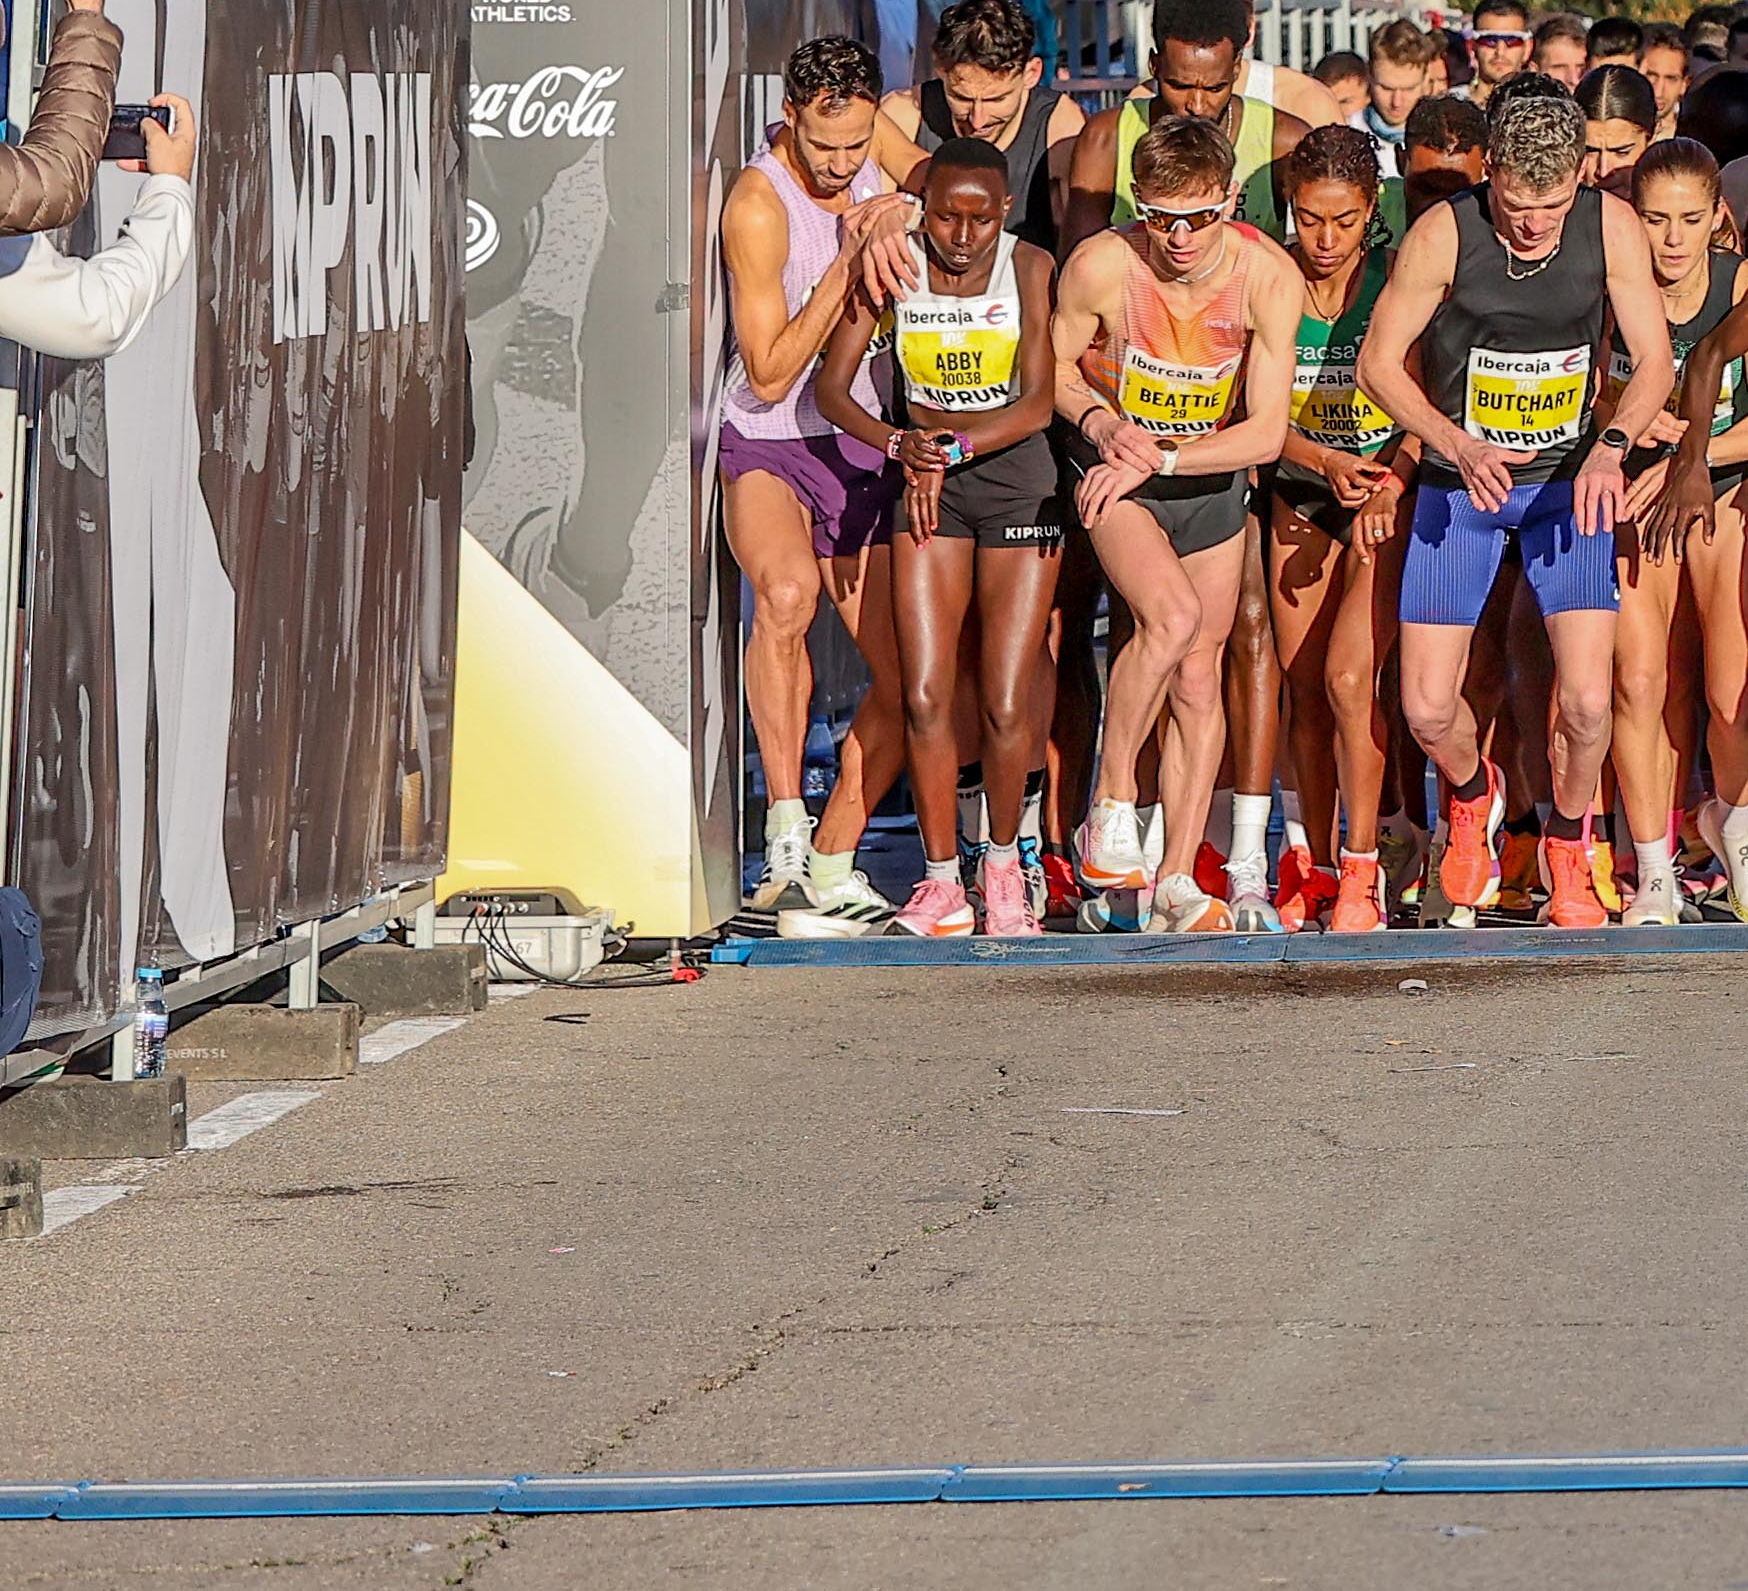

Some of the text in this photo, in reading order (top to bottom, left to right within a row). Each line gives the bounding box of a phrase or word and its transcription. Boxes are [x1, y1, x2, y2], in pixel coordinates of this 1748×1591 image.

[469, 65, 625, 140] ca-Cola
[268, 72, 432, 346] KIPRUN
[903, 308, 973, 326] Ibercaja
[936, 350, 983, 371] ABBY
[1131, 353, 1204, 381] Ibercaja
[1477, 355, 1551, 374] Ibercaja
[941, 371, 982, 386] 20038
[1294, 371, 1354, 387] ercaja
[923, 384, 1009, 406] KIPRUN
[1139, 386, 1222, 409] BEATTIE
[1477, 388, 1578, 413] BUTCHART
[1169, 408, 1188, 420] 29
[1311, 403, 1374, 419] LIKINA
[1520, 414, 1534, 426] 14
[1131, 413, 1220, 435] KIPRUN
[1321, 418, 1363, 432] 20002
[1300, 425, 1391, 446] KIPRUN
[1481, 426, 1567, 447] KIPRUN
[1005, 525, 1061, 540] KIPRUN
